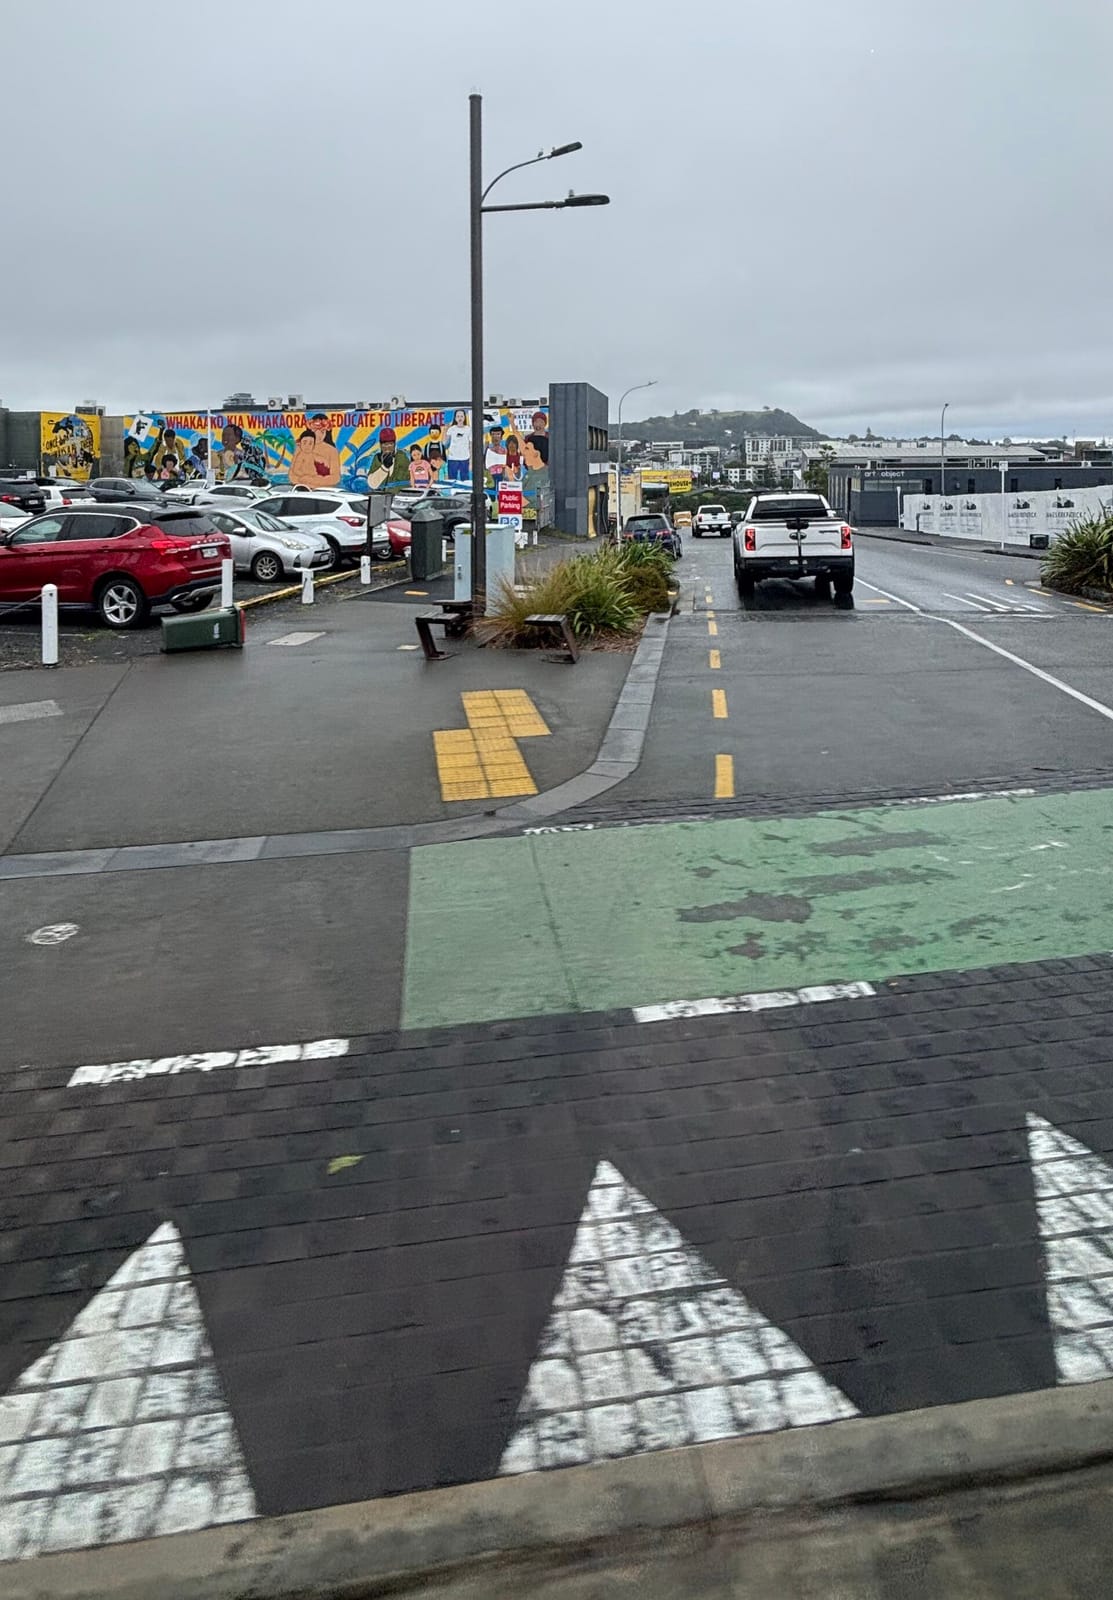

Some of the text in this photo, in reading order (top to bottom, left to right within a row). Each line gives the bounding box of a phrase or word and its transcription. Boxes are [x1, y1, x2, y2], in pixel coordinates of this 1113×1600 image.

[227, 415, 244, 429] KIA
[247, 413, 306, 429] WHAKAORA
[330, 411, 446, 428] EDUCATE TO LIBERATE
[880, 470, 905, 479] object
[500, 502, 521, 510] Parking
